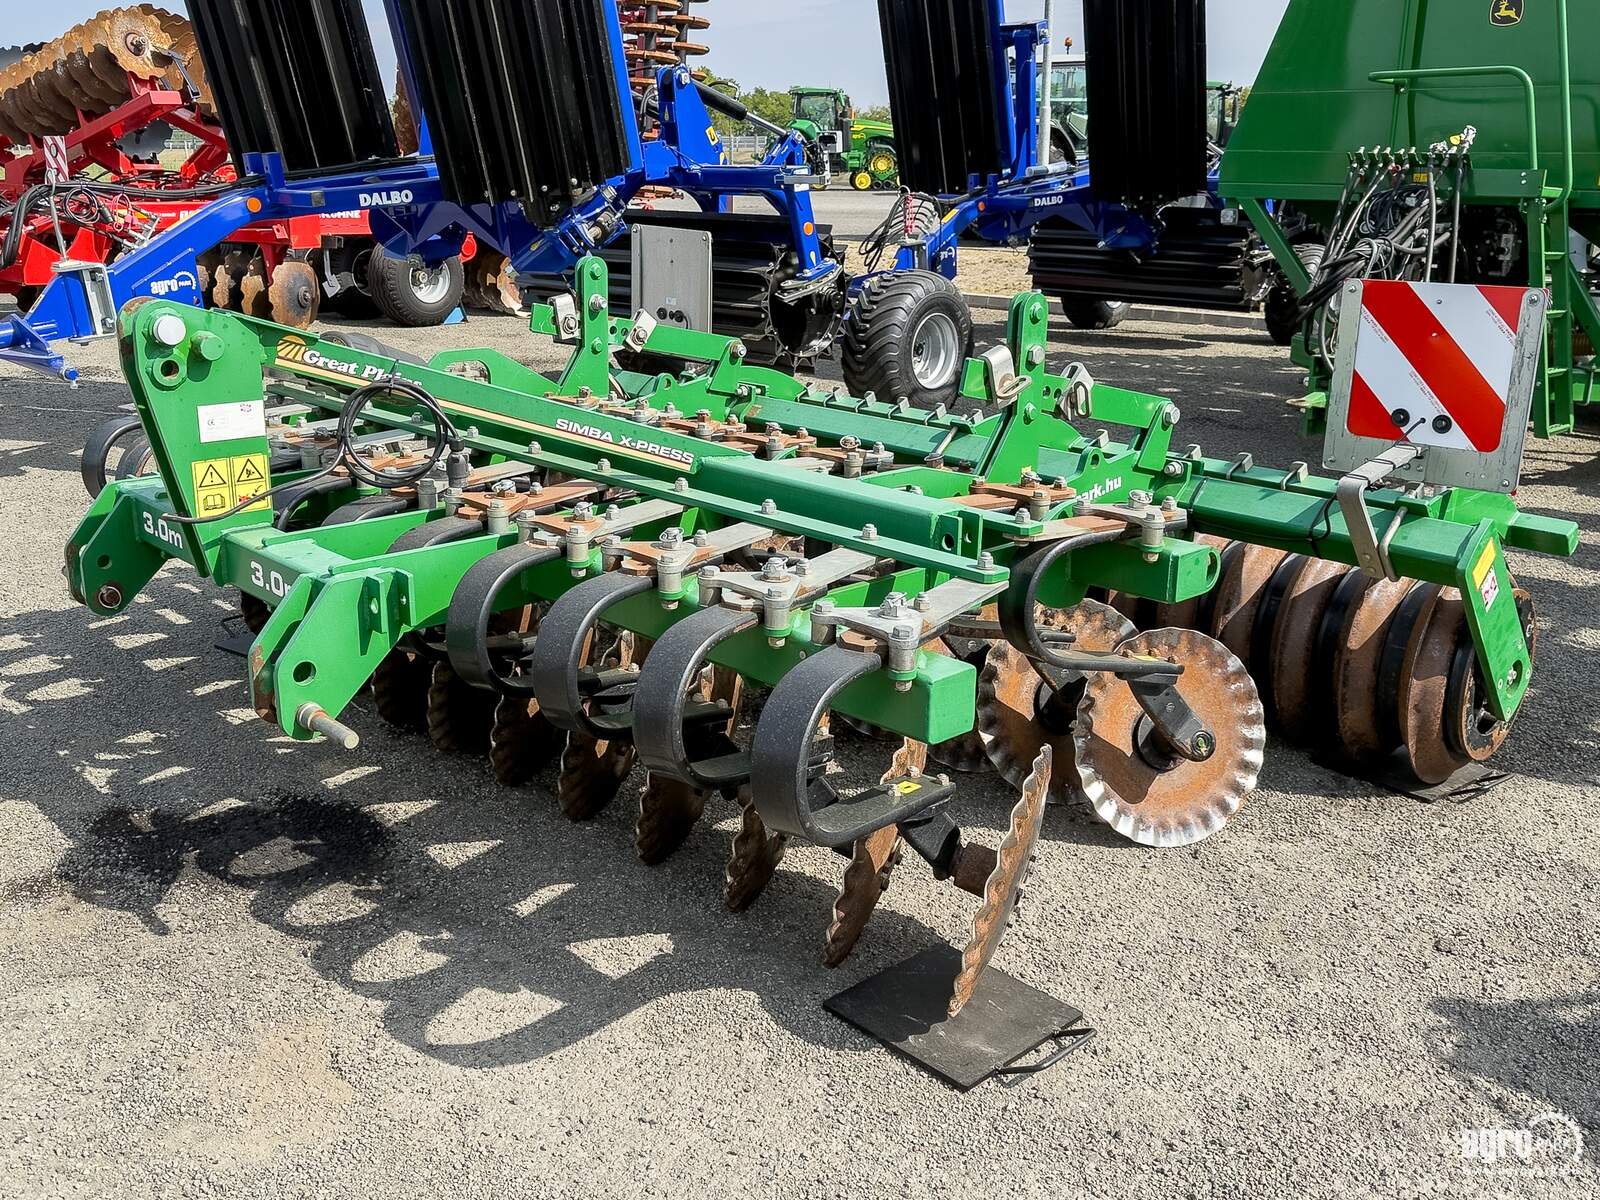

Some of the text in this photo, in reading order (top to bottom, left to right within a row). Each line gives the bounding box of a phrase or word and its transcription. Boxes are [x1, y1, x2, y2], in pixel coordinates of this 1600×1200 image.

[359, 189, 413, 207] DALBO
[1034, 195, 1063, 207] DALBO
[150, 279, 178, 296] agro
[302, 349, 359, 375] Great
[555, 418, 695, 464] SIMBA X-PRESS
[1075, 476, 1122, 501] ark.hu
[142, 511, 184, 549] 3.0m
